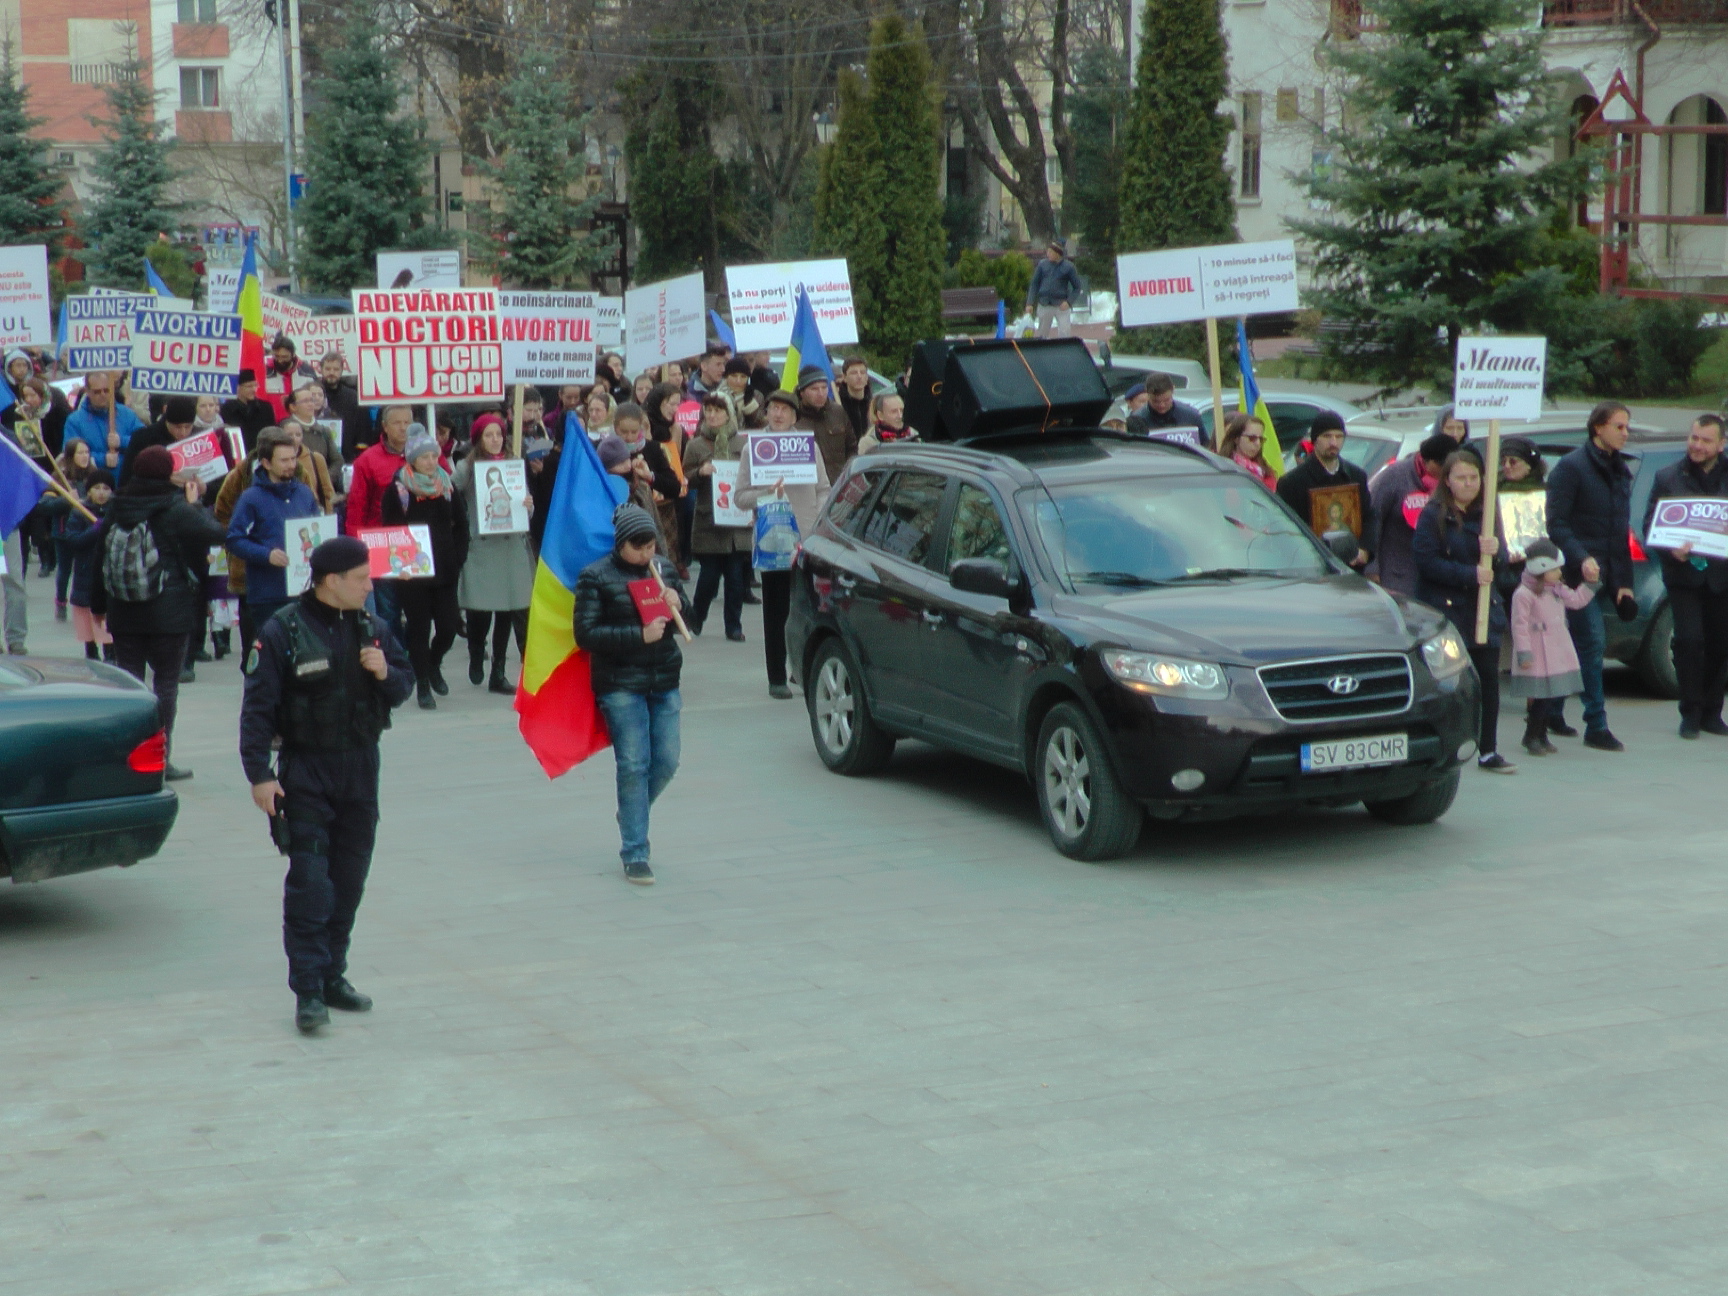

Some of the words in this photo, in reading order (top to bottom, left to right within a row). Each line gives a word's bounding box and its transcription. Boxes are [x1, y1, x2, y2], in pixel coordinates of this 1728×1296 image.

[1223, 255, 1257, 267] minute
[744, 289, 759, 298] nu
[815, 281, 850, 293] uciderea
[1129, 277, 1195, 297] AVORTUL
[359, 289, 496, 314] ADEVĂRAȚII
[140, 311, 238, 338] AVORTUL
[359, 315, 499, 343] DOCTORI
[501, 317, 594, 342] AVORTUL
[735, 314, 757, 325] este
[74, 321, 131, 343] IARTĂ
[150, 340, 230, 368] UCIDE
[303, 339, 345, 356] ESTE
[431, 346, 500, 370] UCID
[527, 350, 538, 361] te
[539, 350, 560, 361] face
[563, 351, 593, 361] mama
[361, 347, 429, 396] NU
[1459, 348, 1541, 374] Mama,
[137, 369, 235, 394] ROMÂNIA
[432, 371, 501, 395] COPII
[515, 367, 538, 378] unui
[540, 367, 564, 379] copil
[779, 437, 810, 453] 80%
[1690, 503, 1728, 520] 80%
[1313, 744, 1338, 765] SV
[1345, 738, 1405, 762] 83CMR
